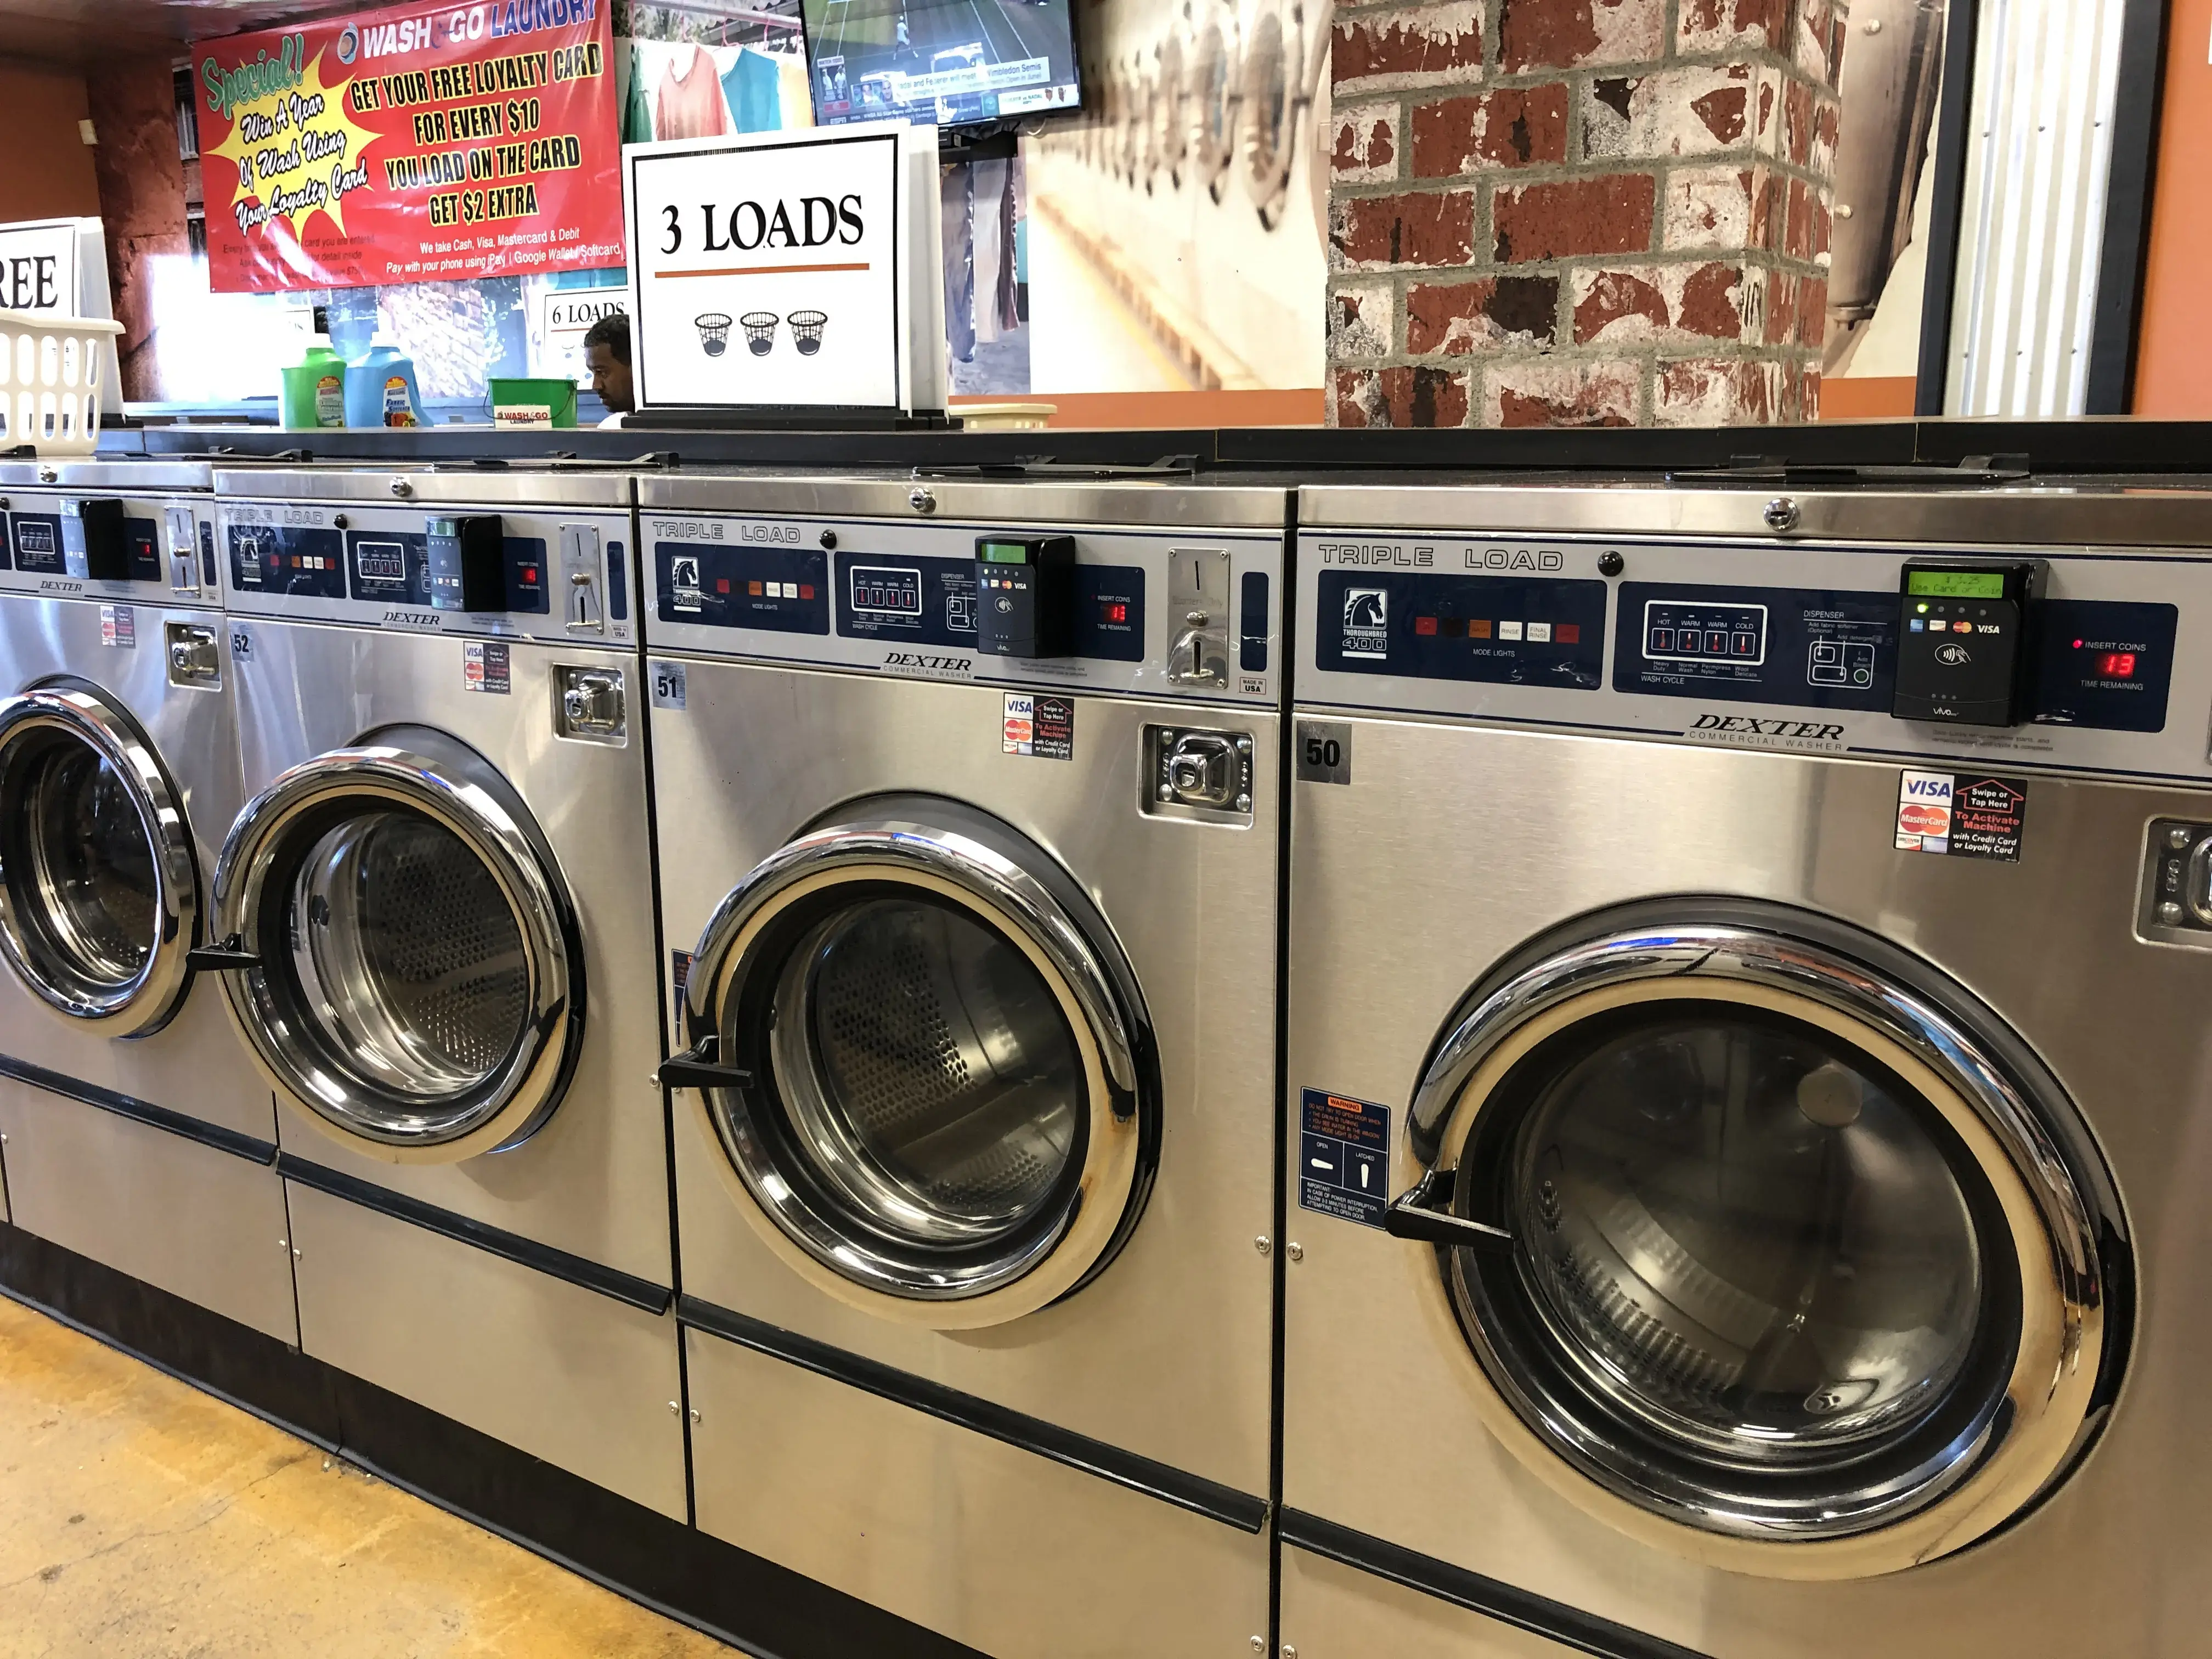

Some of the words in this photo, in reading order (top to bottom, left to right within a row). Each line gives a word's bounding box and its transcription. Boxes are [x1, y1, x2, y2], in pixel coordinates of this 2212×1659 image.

[363, 19, 431, 58] WASH
[449, 7, 484, 43] GO
[351, 77, 380, 112] GET
[382, 72, 428, 108] YOUR
[431, 64, 471, 100] FREE
[475, 52, 548, 94] LOYALTY
[552, 42, 603, 83] CARD
[240, 112, 273, 144] Win
[275, 99, 289, 134] A
[289, 92, 324, 132] Year
[413, 111, 446, 146] FOR
[450, 103, 504, 142] EVERY
[507, 98, 541, 137] $10
[239, 156, 253, 193] Of
[257, 139, 301, 179] Wash
[302, 129, 347, 162] Using
[385, 156, 419, 191] YOU
[420, 148, 465, 186] LOAD
[468, 143, 493, 182] ON
[495, 139, 527, 176] THE
[528, 134, 582, 171] CARD
[236, 201, 267, 236] Your
[269, 178, 329, 217] Loyalty
[331, 156, 368, 200] Card
[428, 193, 458, 227] GET
[462, 189, 483, 225] $2
[488, 182, 540, 219] EXTRA
[661, 205, 681, 254] 3
[701, 195, 864, 251] LOADS
[420, 242, 433, 254] We
[435, 239, 452, 253] take
[453, 235, 474, 252] Cash,
[477, 234, 495, 249] Visa,
[497, 230, 548, 246] Mastercard
[550, 230, 556, 241] &
[559, 228, 580, 241] Debit
[387, 262, 403, 274] Pay
[405, 259, 420, 272] with
[422, 258, 439, 273] your
[441, 256, 463, 271] phone
[465, 253, 486, 269] using
[488, 251, 505, 268] iPay
[514, 248, 546, 264] Google
[580, 243, 620, 258] Softcard
[552, 305, 561, 324] 6
[568, 302, 624, 323] LOADS
[284, 510, 323, 524] LOAD
[653, 522, 724, 539] TRIPLE
[741, 526, 800, 543] LOAD
[1318, 544, 1434, 567] TRIPLE
[1465, 549, 1564, 571] LOAD
[40, 580, 82, 592] DEXTER
[1912, 583, 1928, 591] Use
[1934, 584, 1956, 592] Card
[1978, 584, 2001, 594] Coin
[673, 594, 701, 606] 400
[382, 612, 440, 625] DEXTER
[1803, 610, 1844, 619] DISPENSER
[1343, 629, 1387, 638] THOROUGHBRED
[1977, 624, 2000, 634] VISA
[234, 634, 249, 652] 52
[1342, 637, 1387, 651] 400
[2085, 641, 2117, 650] INSERT
[2119, 643, 2146, 652] COINS
[466, 647, 483, 657] VISA
[883, 652, 971, 671] DEXTER
[2108, 654, 2135, 675] 13
[884, 665, 934, 675] COMMERCIAL
[939, 671, 971, 679] WASHER
[658, 676, 677, 698] 51
[2100, 681, 2143, 691] REMAINING
[1008, 699, 1032, 713] VISA
[1005, 726, 1031, 735] MasterCard
[1689, 714, 1845, 740] DEXTER
[1689, 731, 1776, 746] COMMERCIAL
[1786, 738, 1843, 751] WASHER
[1306, 739, 1340, 767] 50
[1906, 779, 1951, 798] VISA
[1972, 788, 1996, 798] Swipe
[1971, 798, 1986, 808] Tap
[1988, 799, 2008, 809] Here
[1900, 814, 1948, 827] MasterCard
[1955, 811, 1968, 820] To
[1971, 813, 2020, 826] Activate
[1963, 821, 2011, 833] Machine
[1972, 834, 1995, 844] Credit
[1997, 837, 2017, 846] Card
[1965, 842, 1991, 853] Loyalty
[1994, 846, 2013, 854] Card
[1330, 1098, 1359, 1111] WARNING
[1356, 1152, 1374, 1161] LATCHED
[1331, 1194, 1346, 1203] POWER
[1307, 1200, 1332, 1211] ATTEMPTING
[1340, 1209, 1351, 1217] OPEN
[1329, 1200, 1346, 1209] MINUTES
[1347, 1205, 1364, 1214] BEFORE
